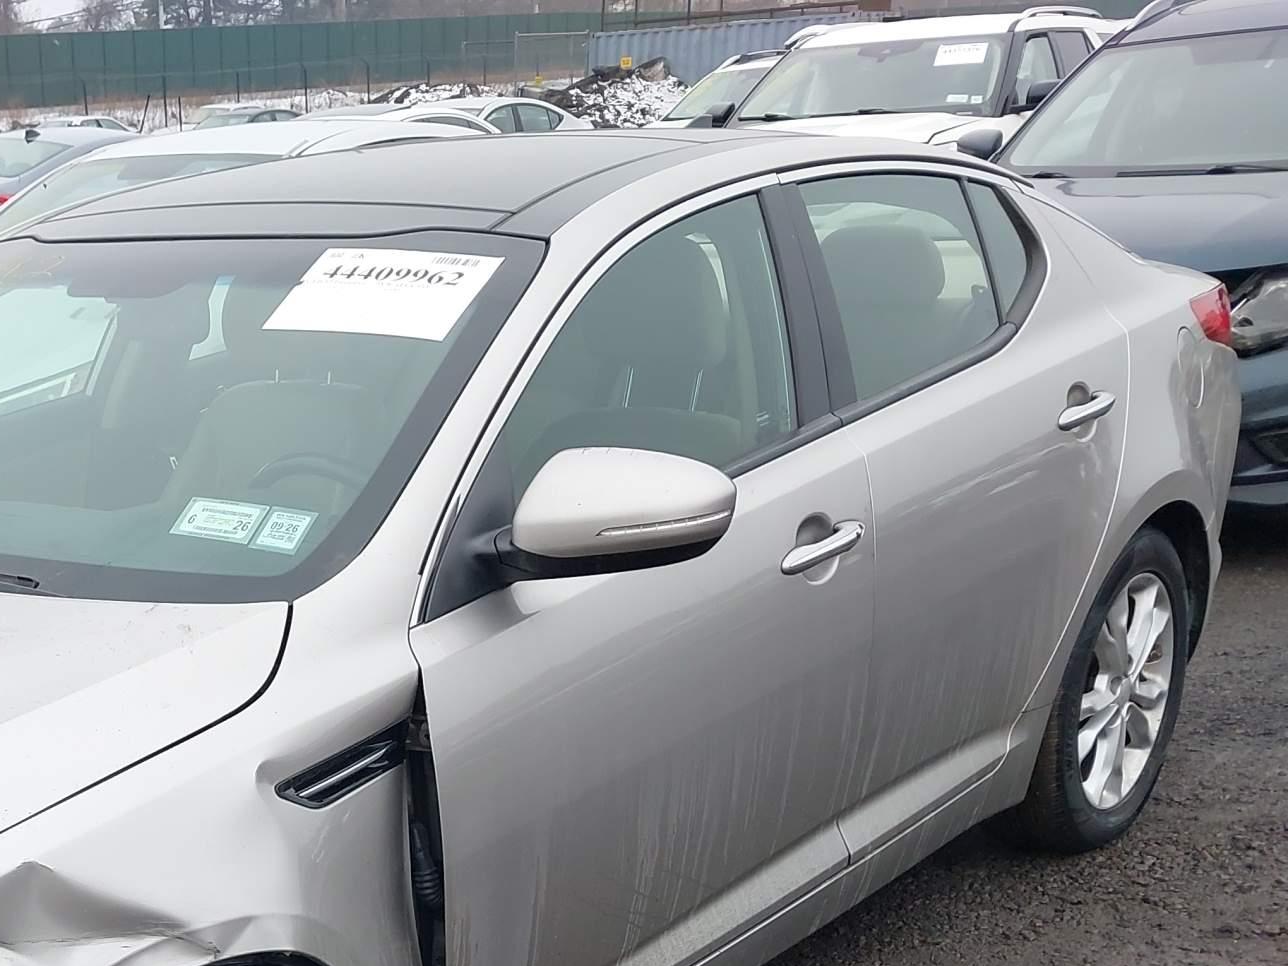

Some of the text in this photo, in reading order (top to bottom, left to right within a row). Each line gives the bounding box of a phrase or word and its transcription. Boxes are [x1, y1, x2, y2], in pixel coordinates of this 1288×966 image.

[322, 264, 465, 286] 44409962
[232, 519, 251, 532] 26
[285, 523, 300, 533] 26
